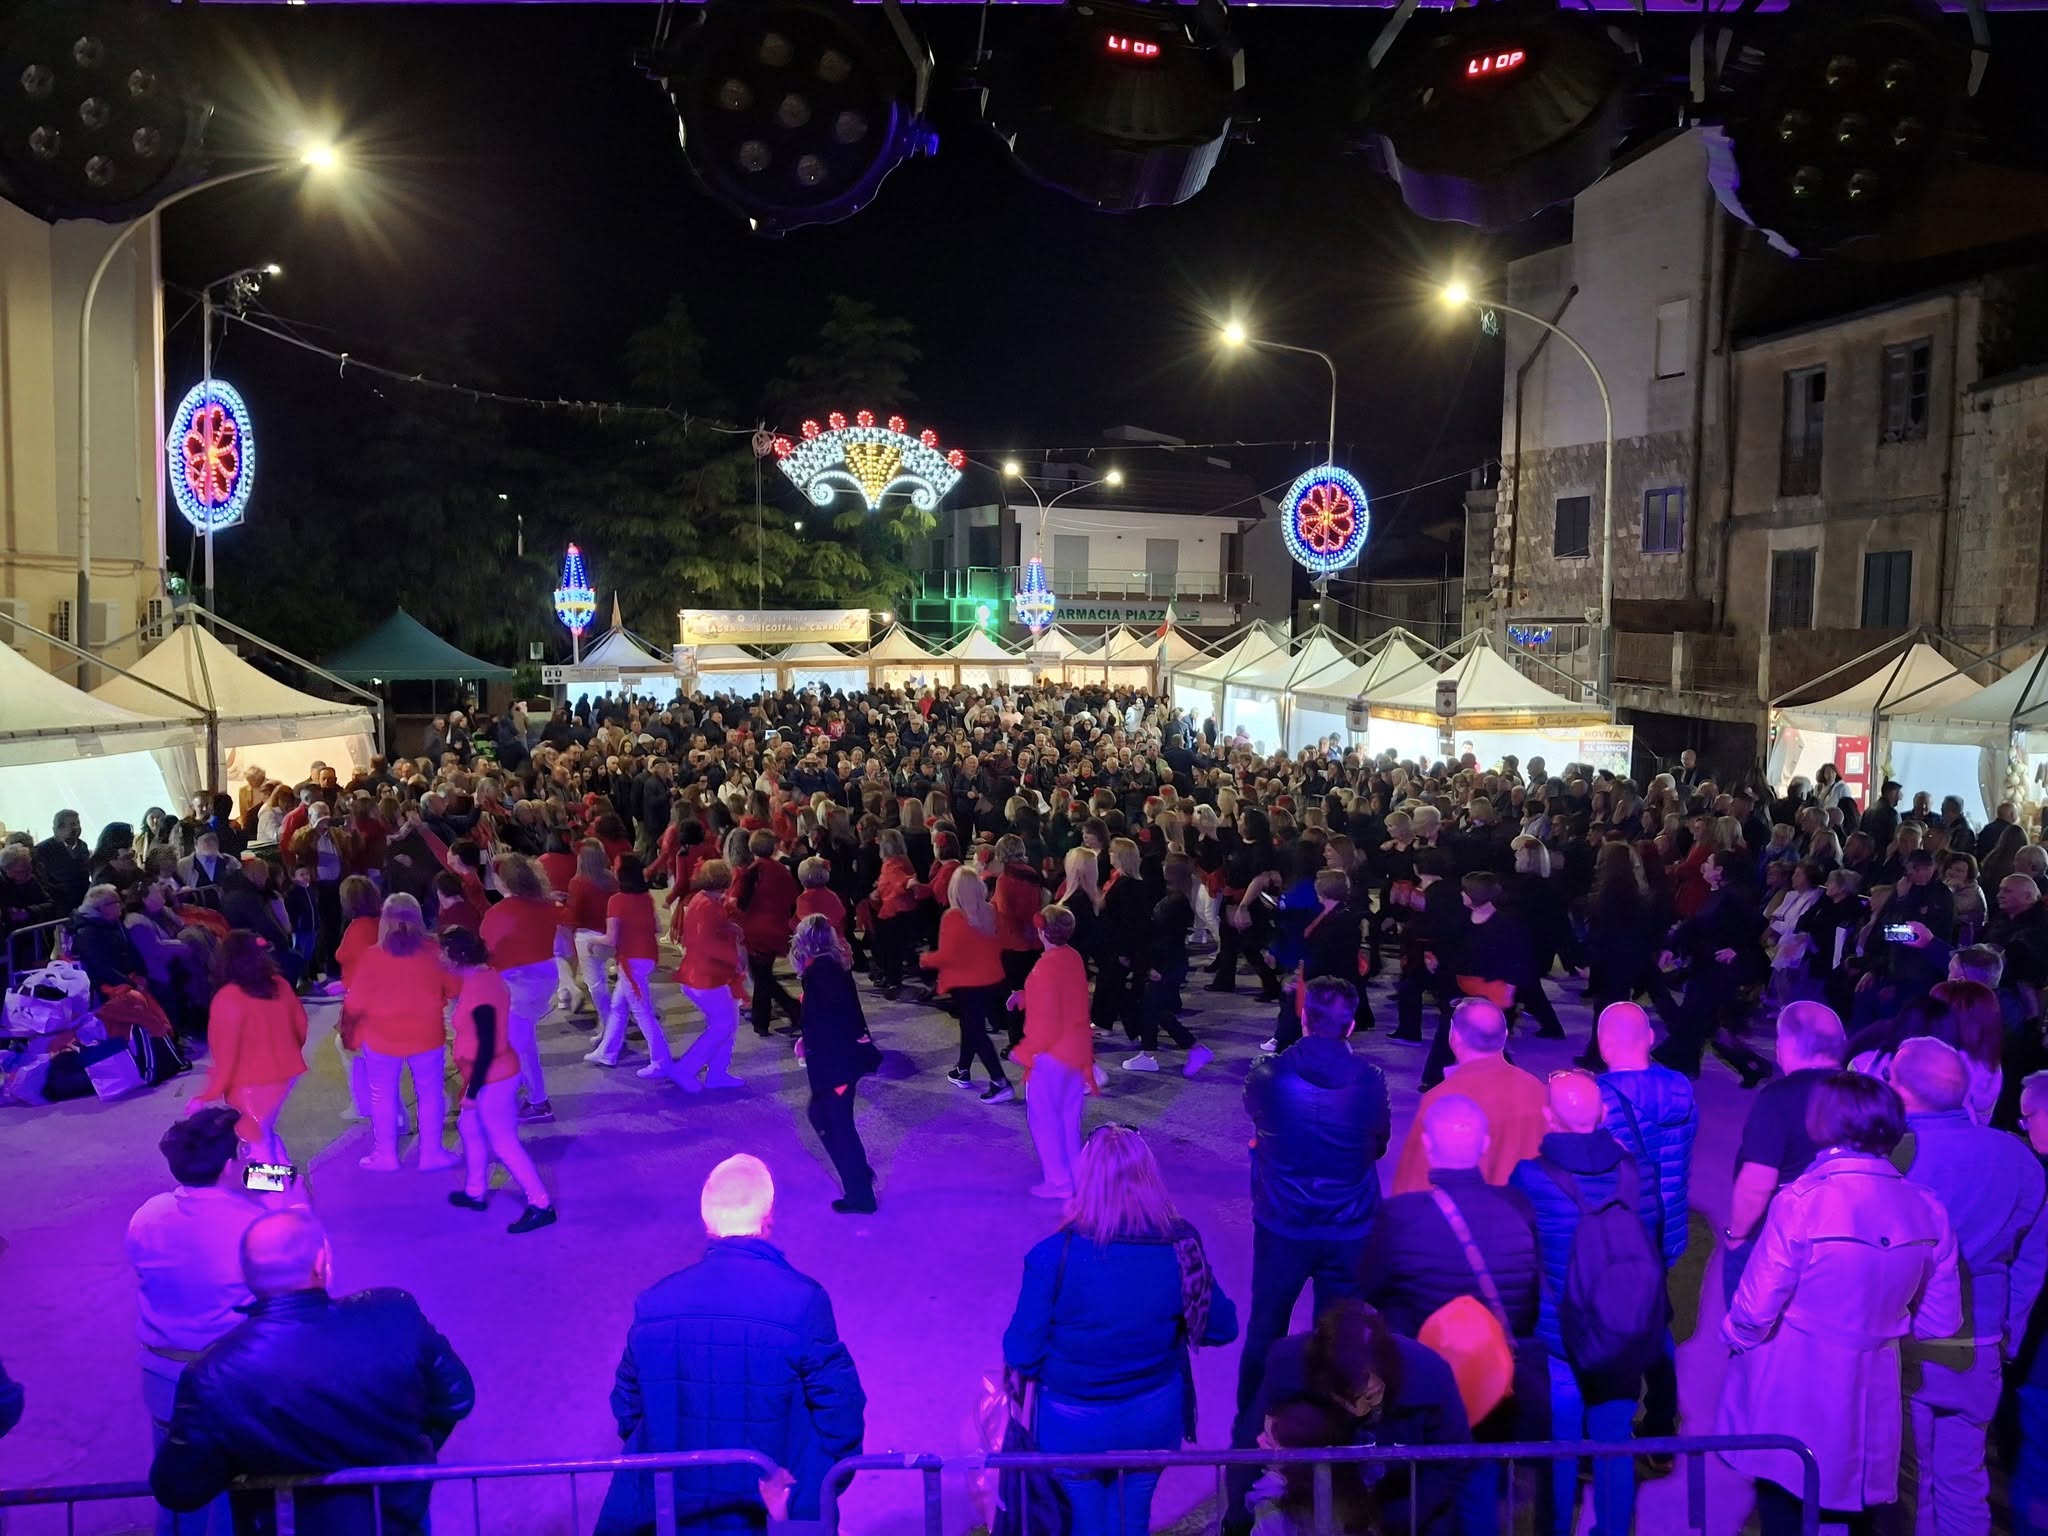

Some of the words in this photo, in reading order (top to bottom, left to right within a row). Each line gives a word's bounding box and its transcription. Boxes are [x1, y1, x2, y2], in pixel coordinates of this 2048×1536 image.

[1056, 608, 1121, 620] ARMACIA
[1125, 609, 1166, 621] PIAZZ
[757, 624, 793, 632] RICOTTA
[1597, 744, 1628, 752] MANGO
